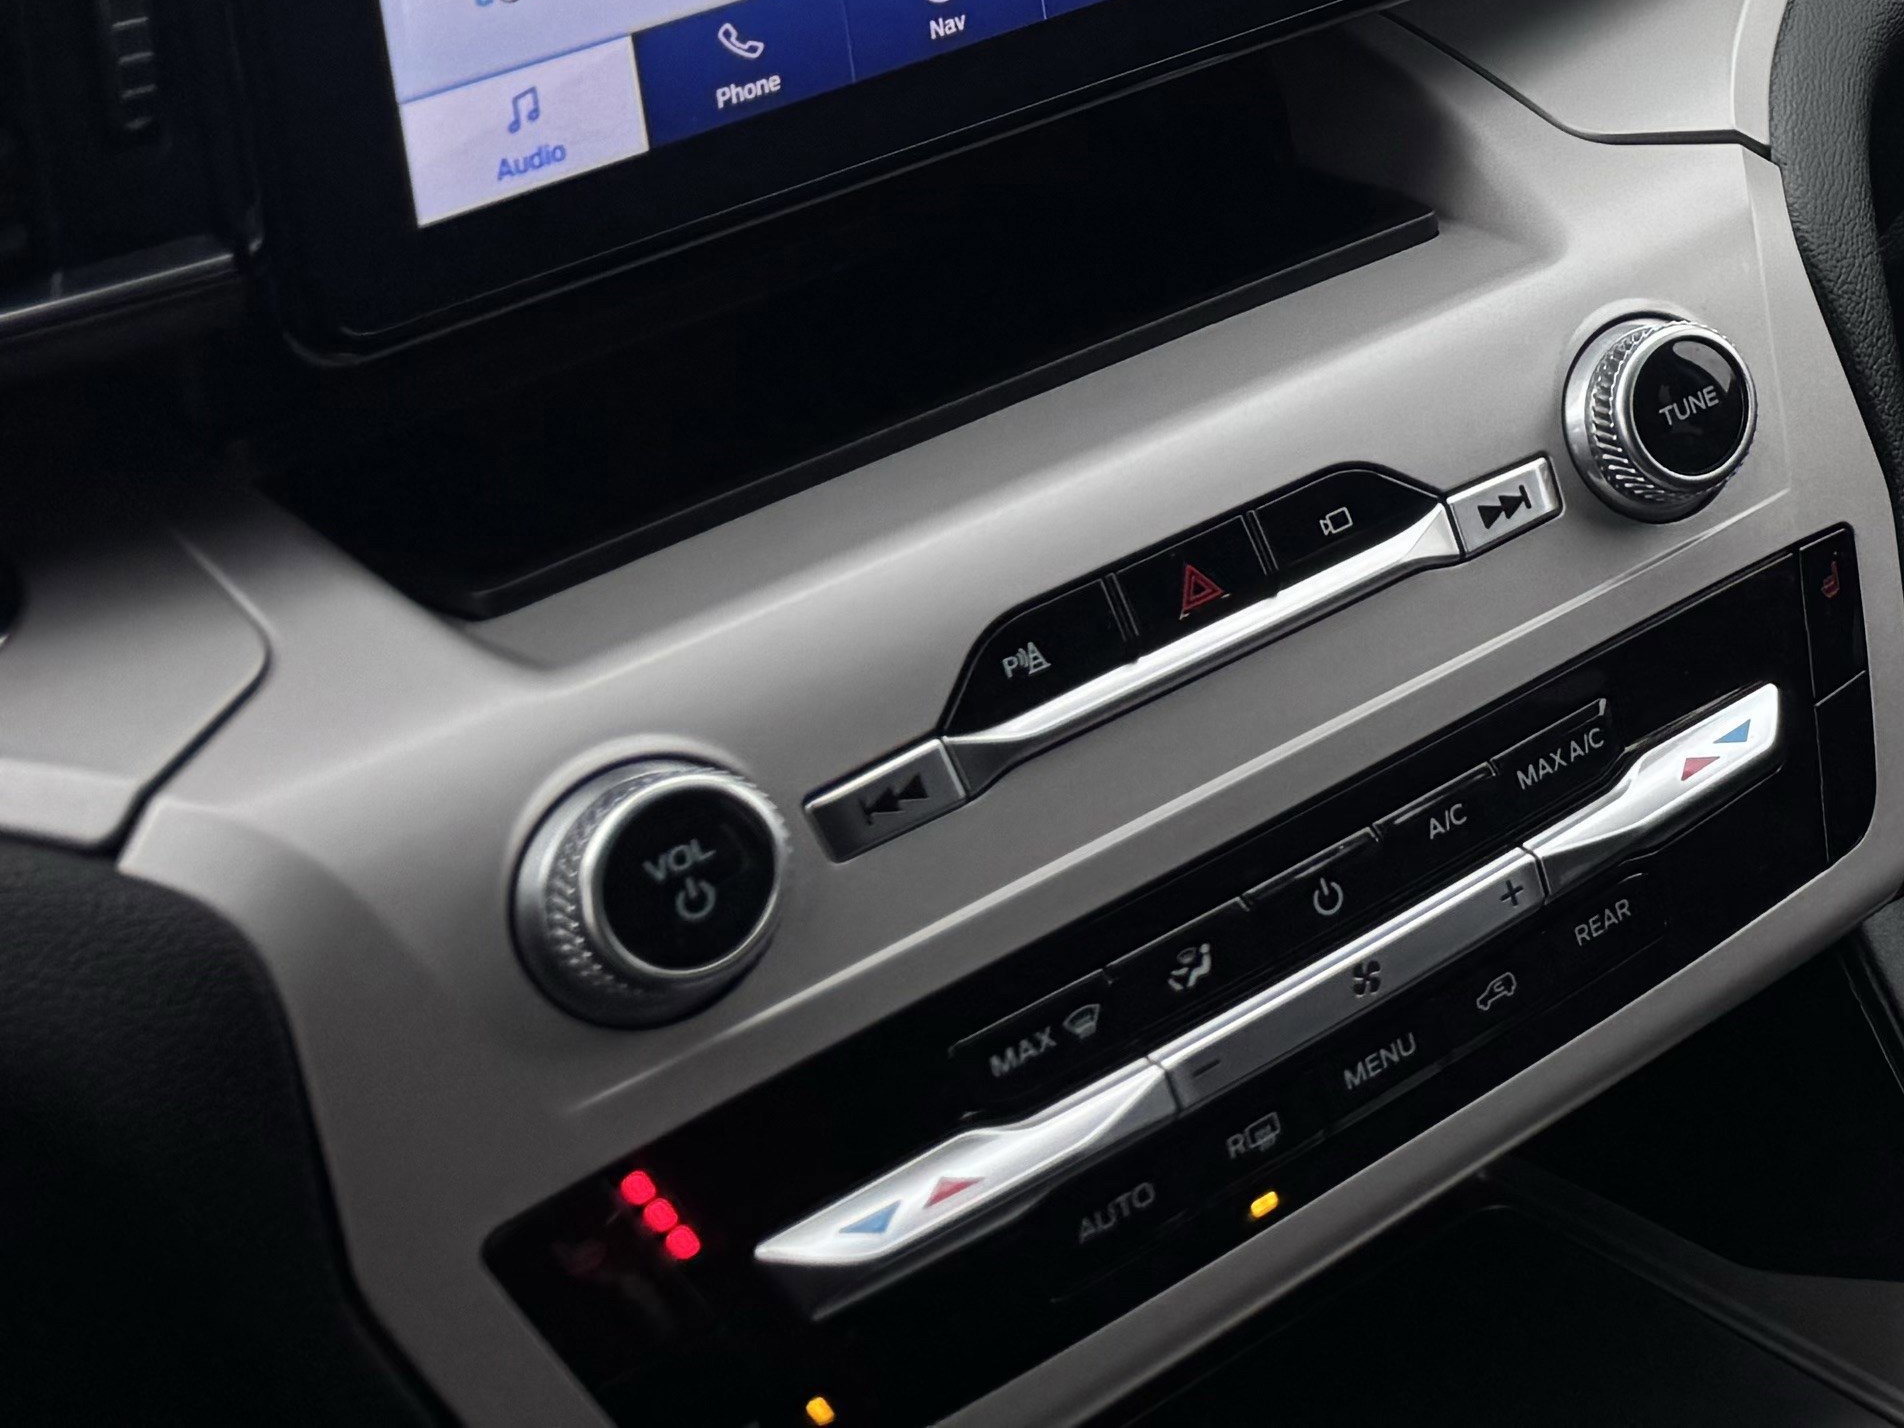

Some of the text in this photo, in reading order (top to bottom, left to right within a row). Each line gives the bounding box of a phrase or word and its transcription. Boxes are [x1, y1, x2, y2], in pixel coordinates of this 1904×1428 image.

[928, 12, 967, 41] Nav
[715, 73, 782, 109] Phone
[496, 143, 568, 181] Audio
[1658, 384, 1721, 429] TUNE
[1516, 727, 1605, 791] MAX A/C
[1429, 803, 1468, 840] A/C
[642, 836, 718, 886] VOL
[1573, 897, 1633, 947] REAR
[989, 1025, 1057, 1078] MAX
[1342, 1031, 1418, 1091] MENU
[1078, 1181, 1156, 1245] AUTO
